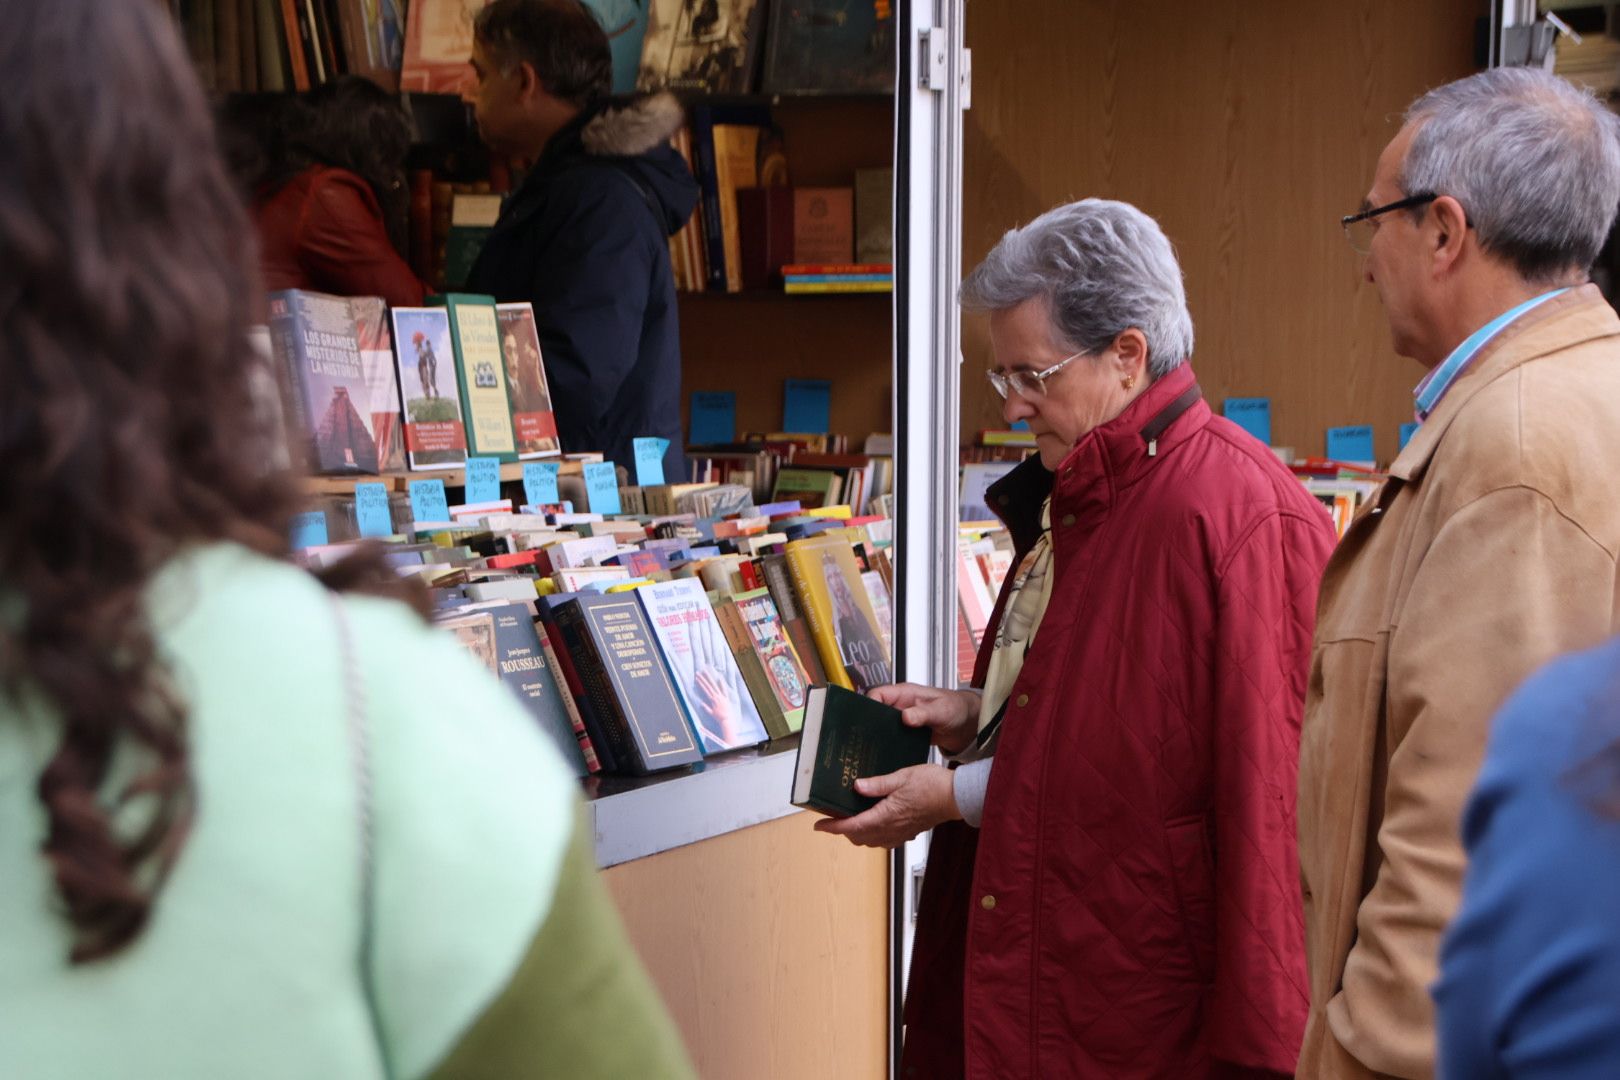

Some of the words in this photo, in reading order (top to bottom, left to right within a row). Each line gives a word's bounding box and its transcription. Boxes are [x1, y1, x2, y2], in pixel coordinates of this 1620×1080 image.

[304, 330, 321, 345] LOS
[321, 333, 357, 351] GRANDES
[305, 345, 349, 363] MISTERIOS
[349, 351, 361, 366] DE
[311, 360, 323, 374] LA
[322, 362, 361, 378] HISTORIA
[835, 635, 870, 667] Leo
[501, 656, 546, 673] ROUSSEAU
